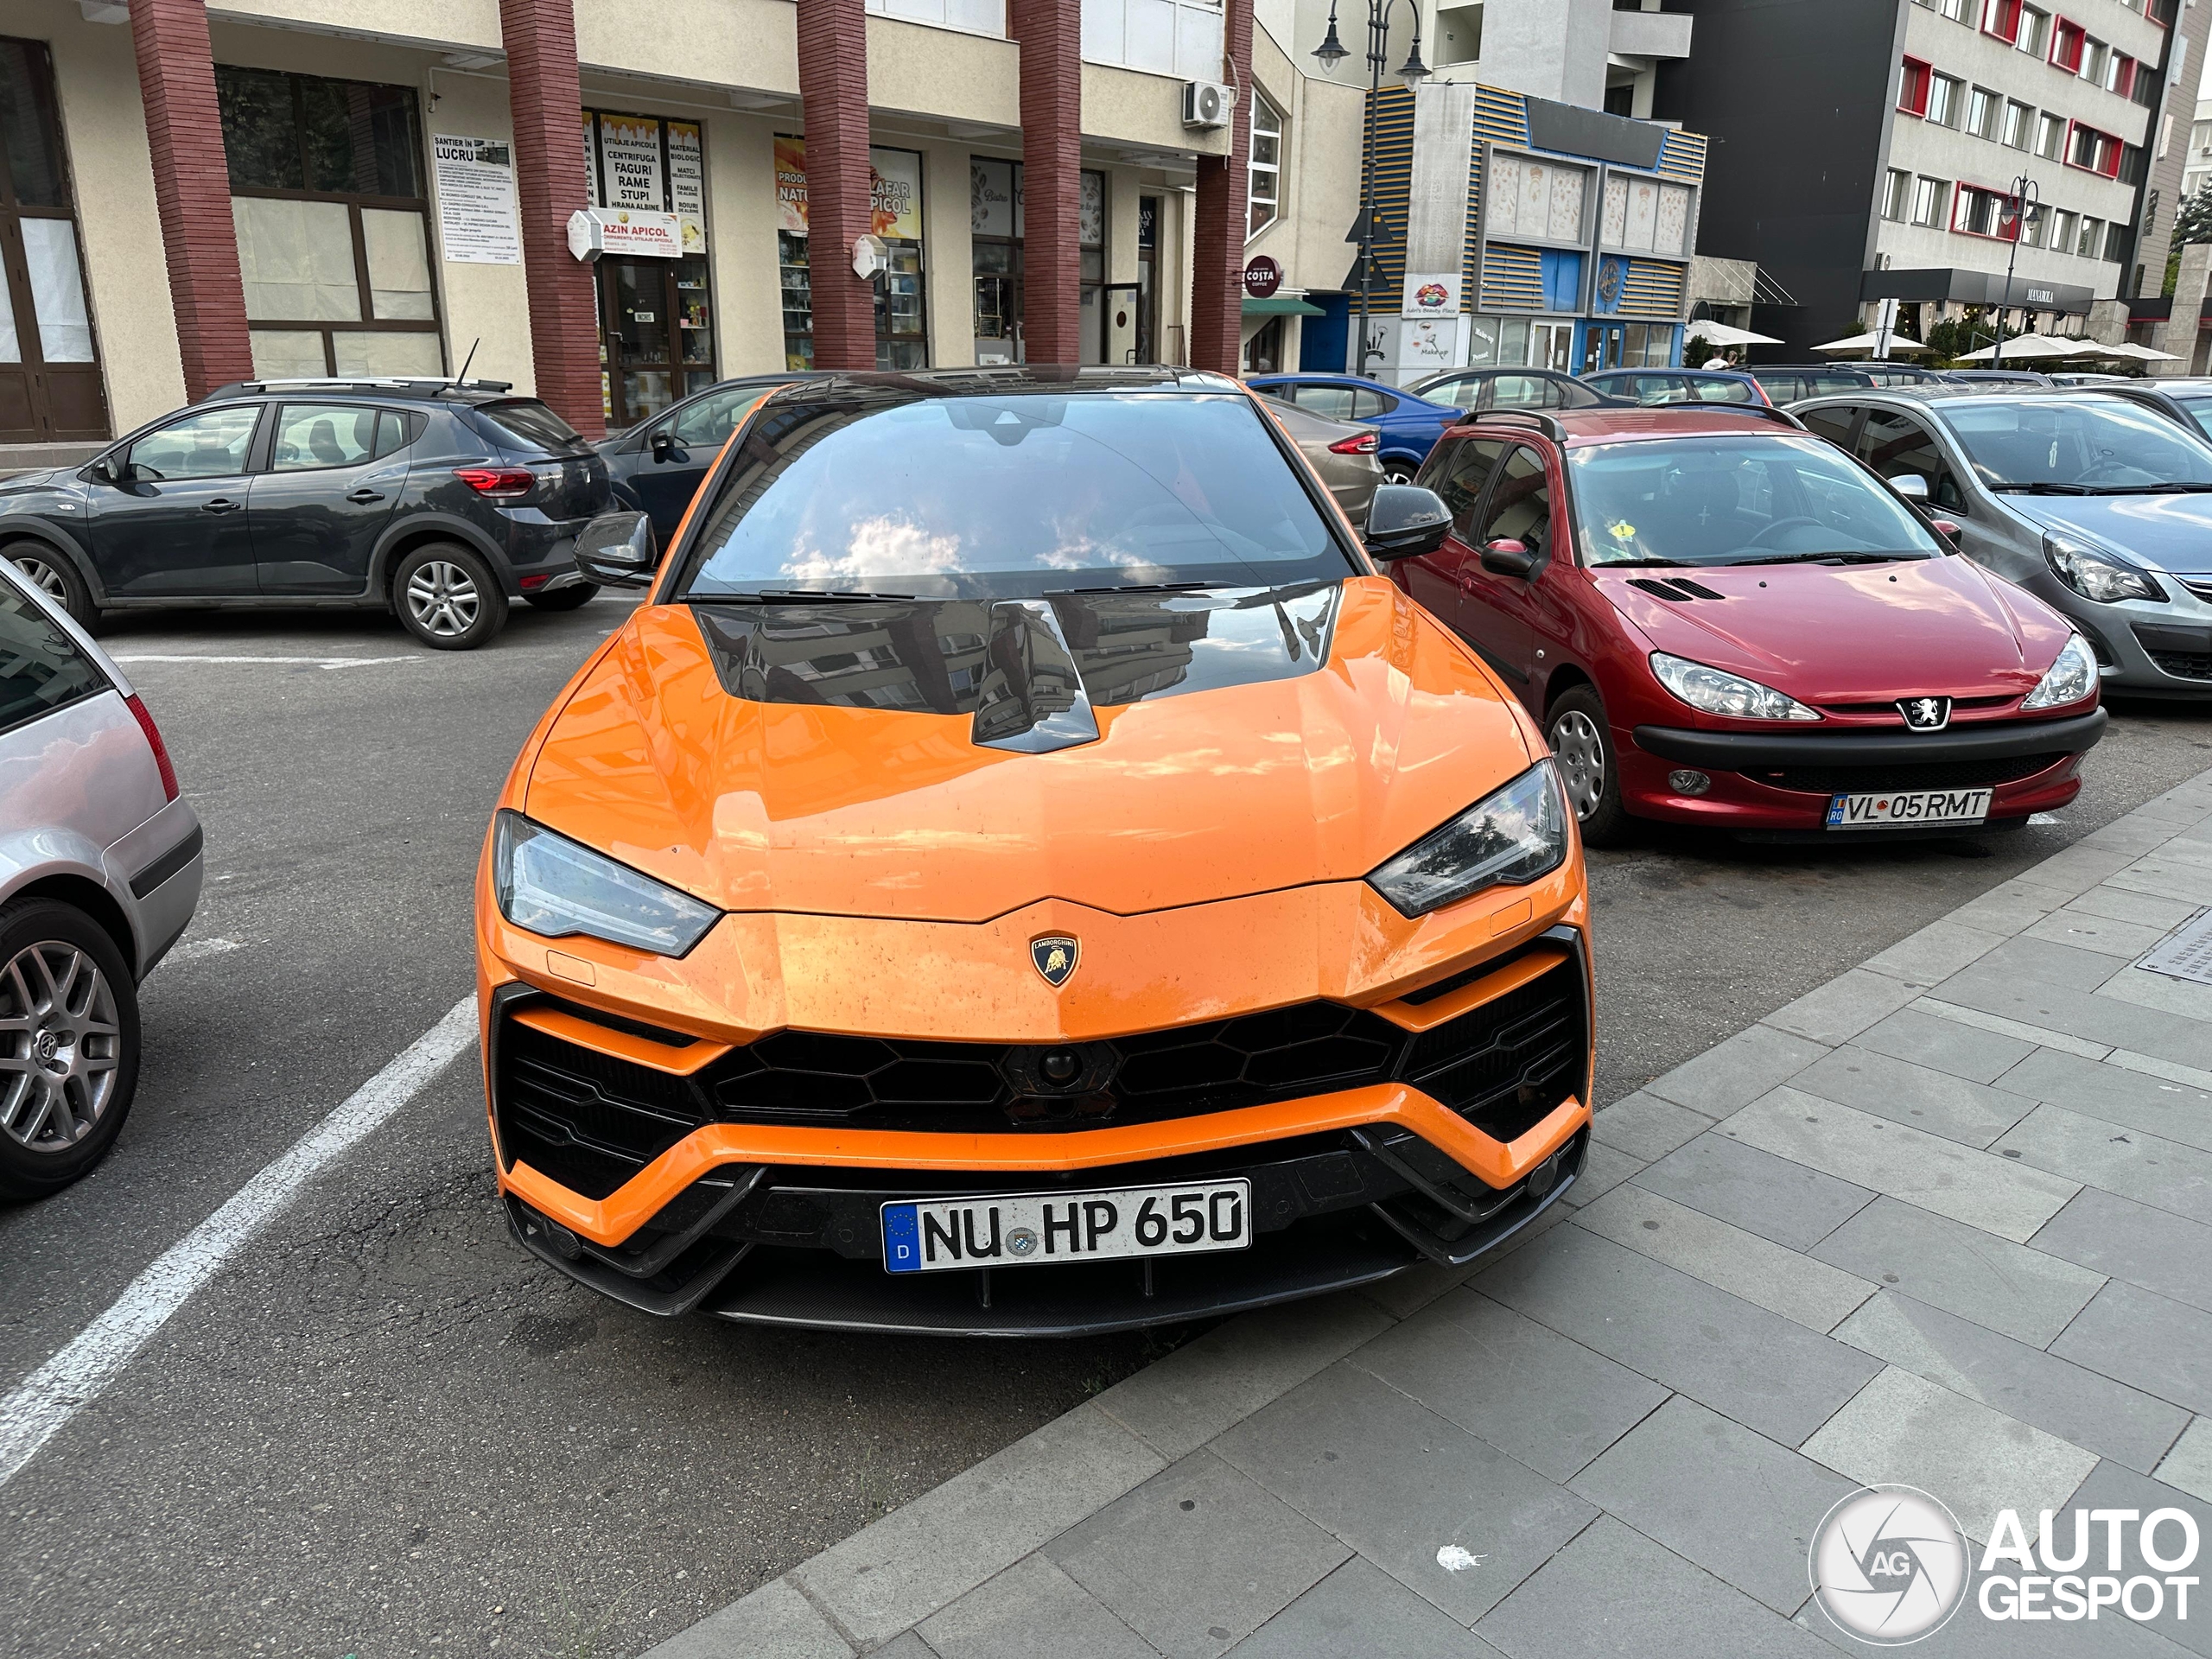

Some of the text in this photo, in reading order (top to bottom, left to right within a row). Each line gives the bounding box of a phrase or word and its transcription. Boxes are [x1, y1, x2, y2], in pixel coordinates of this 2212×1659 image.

[604, 137, 657, 149] UTILAJE APICOLE
[670, 144, 700, 153] MATERIAL
[436, 147, 474, 162] LUCRU
[607, 151, 656, 162] CENTRIFUGA
[671, 154, 701, 162] BIOLOGIC
[614, 162, 652, 175] FAGURI
[619, 175, 651, 188] RAME
[620, 190, 649, 200] STUPI
[984, 188, 1008, 202] Bistro
[612, 201, 659, 211] HRANA ALBINE
[632, 226, 669, 237] APICOL
[1246, 271, 1274, 282] COSTA
[1848, 797, 1878, 820] VL
[1830, 810, 1842, 820] RO
[1034, 939, 1074, 950] LAMBORGHINI
[922, 1207, 1001, 1262] NU
[1043, 1199, 1117, 1254] HP
[1135, 1191, 1242, 1247] 650
[897, 1245, 910, 1259] D
